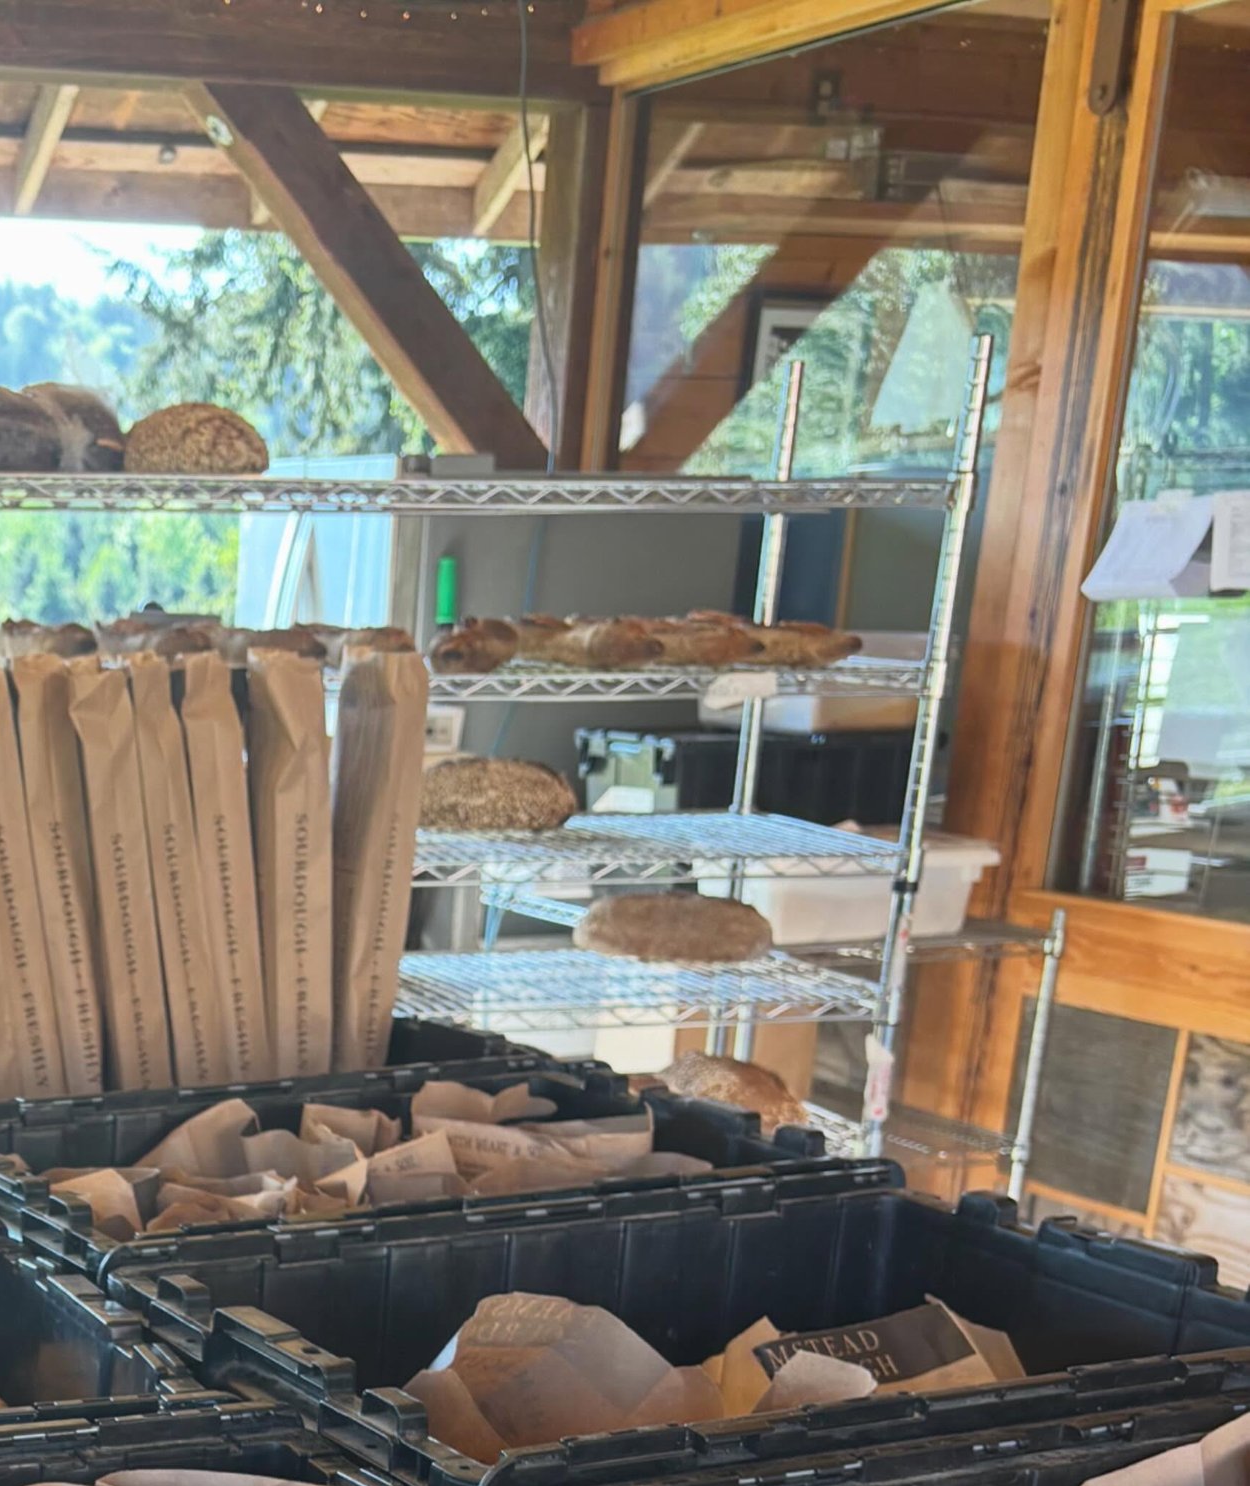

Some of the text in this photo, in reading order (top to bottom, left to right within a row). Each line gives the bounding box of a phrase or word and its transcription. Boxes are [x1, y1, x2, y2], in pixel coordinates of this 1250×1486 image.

[49, 821, 81, 965] SOURDOUGH
[111, 832, 136, 975] SOURDOUGH
[163, 823, 191, 966] SOURDOUGH
[213, 815, 239, 956] SOURDOUGH
[295, 813, 308, 954] SOURDOUGH
[375, 813, 399, 951] SOURDOUGH
